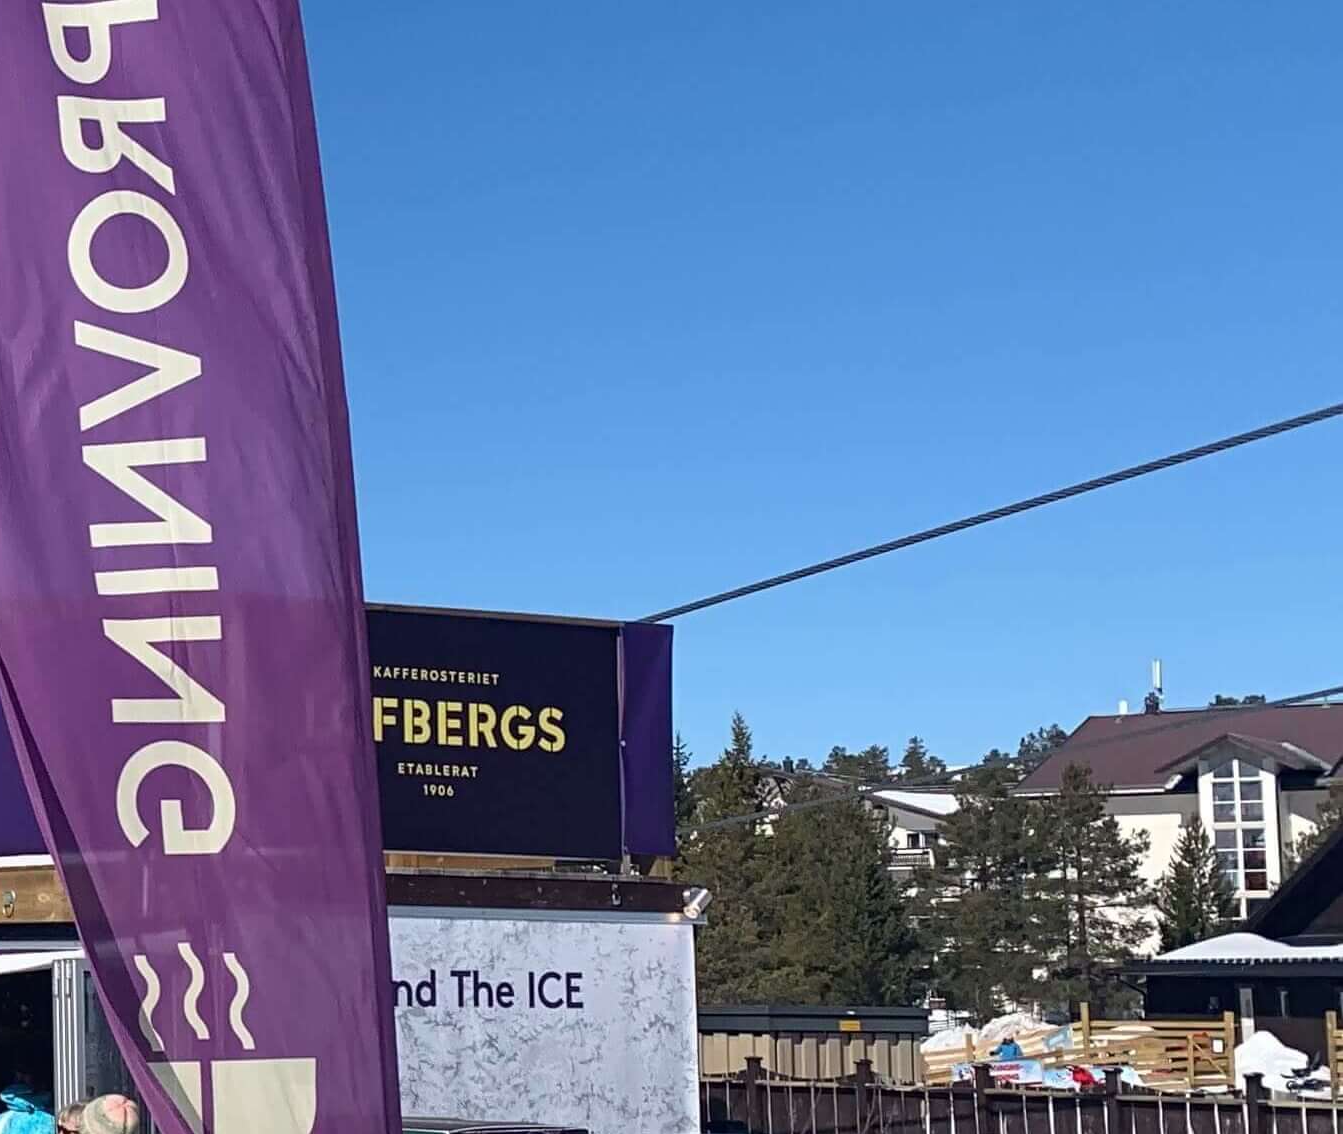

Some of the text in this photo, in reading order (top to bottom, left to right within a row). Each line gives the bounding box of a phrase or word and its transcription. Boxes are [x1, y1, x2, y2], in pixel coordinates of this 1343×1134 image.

[373, 666, 500, 685] KAFFEROSTERIET
[372, 696, 566, 752] FBERGS
[397, 762, 479, 778] ETABLERAT
[422, 783, 455, 797] 1906
[392, 969, 584, 1009] nd The ICE
